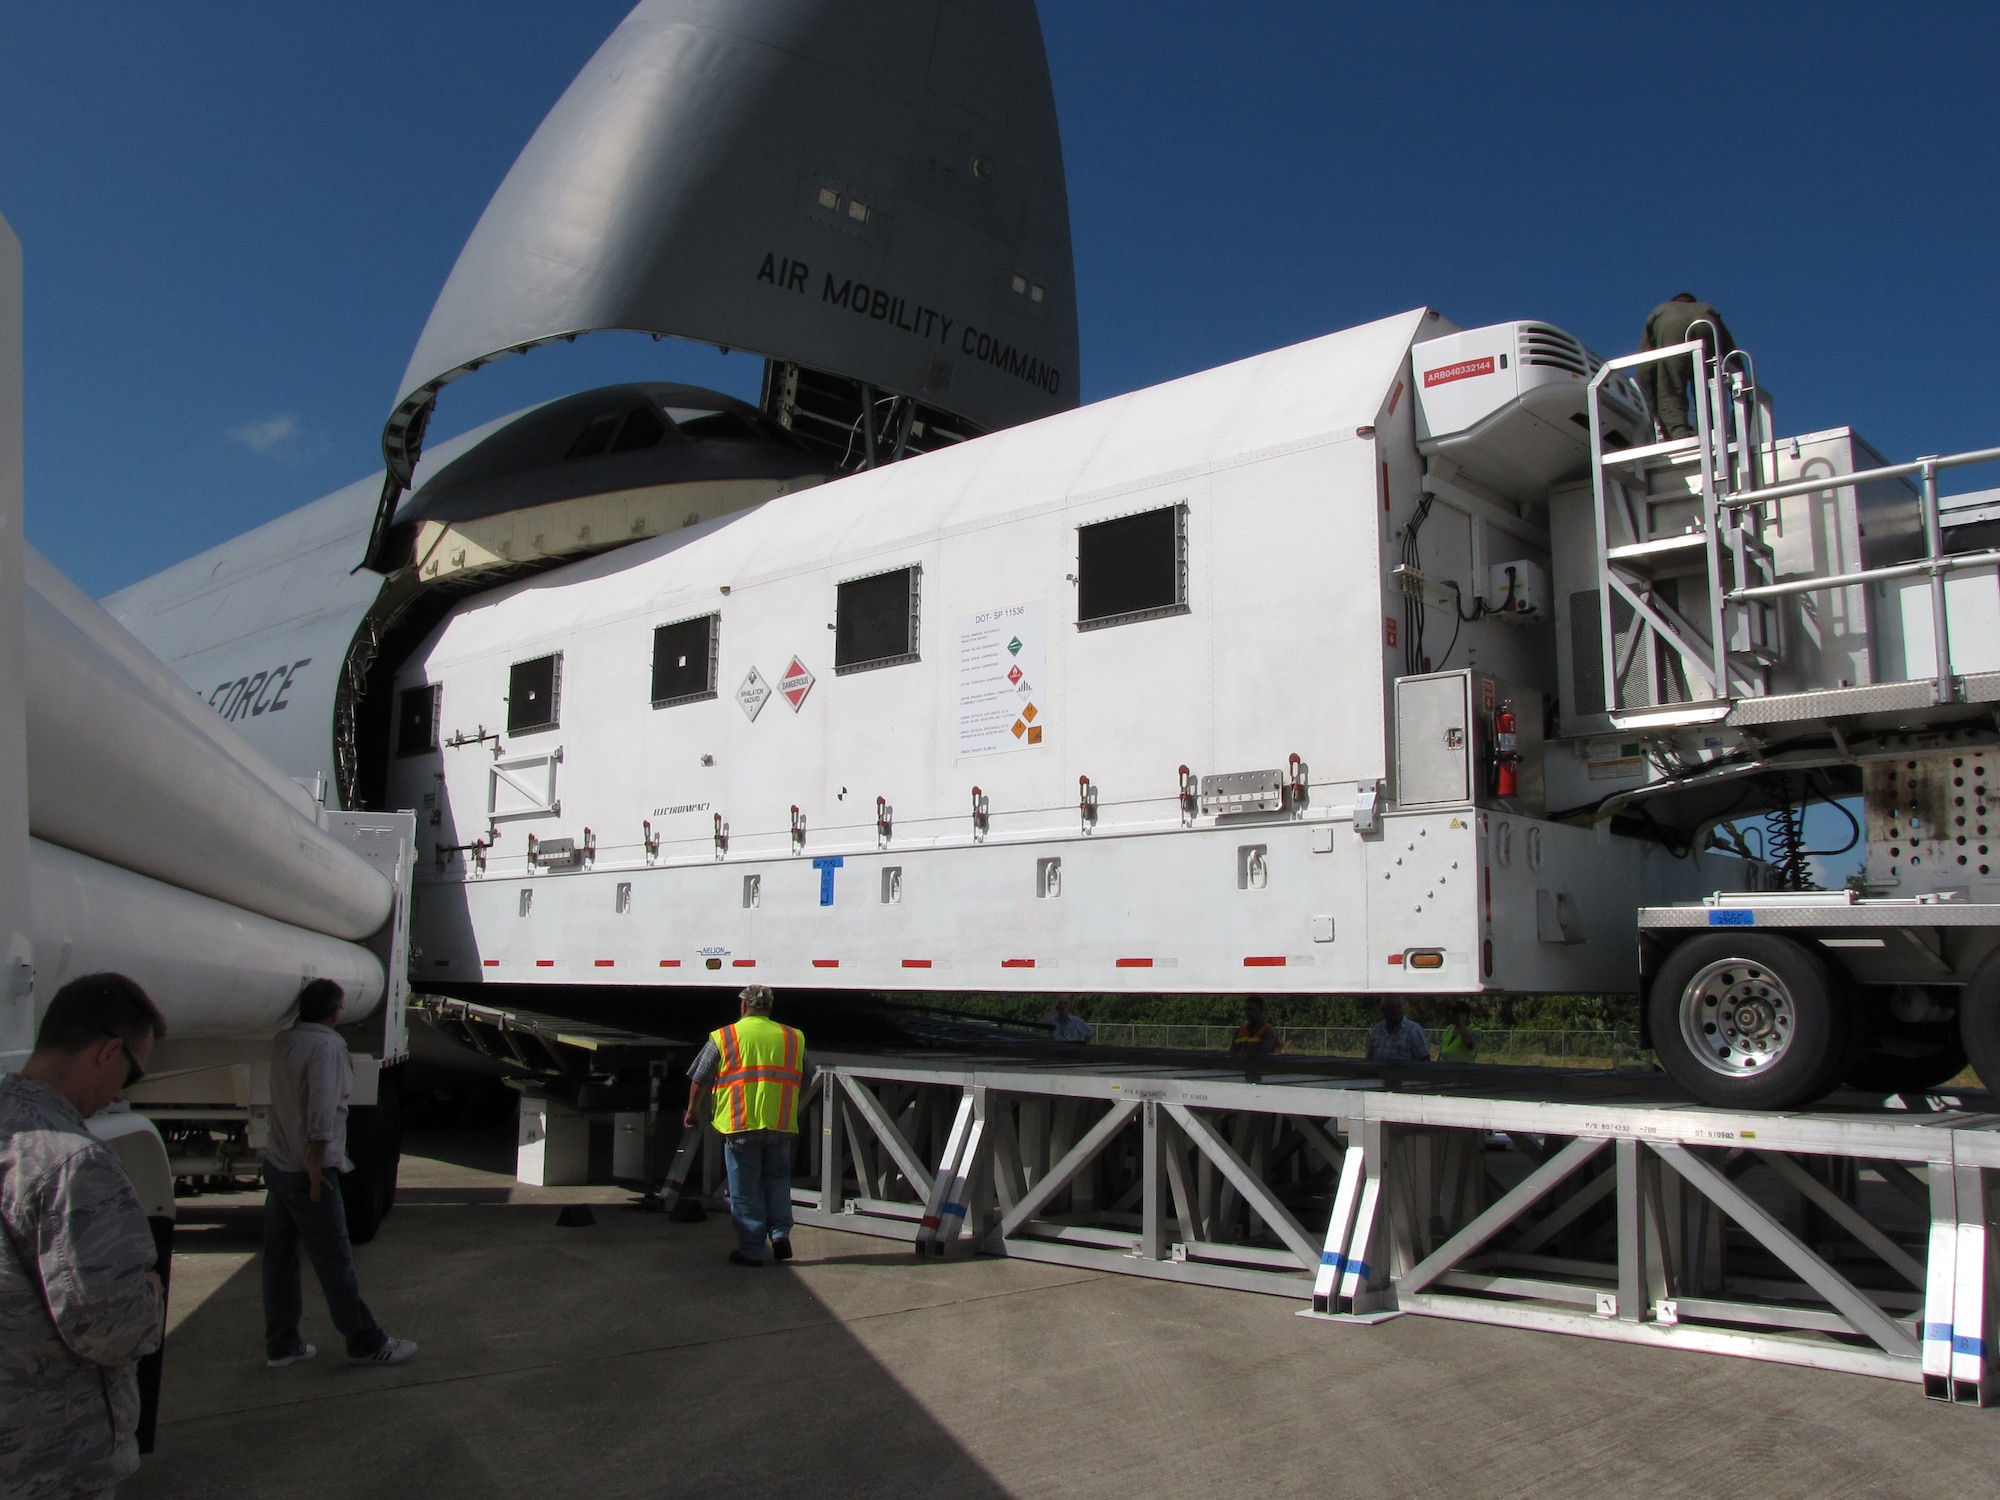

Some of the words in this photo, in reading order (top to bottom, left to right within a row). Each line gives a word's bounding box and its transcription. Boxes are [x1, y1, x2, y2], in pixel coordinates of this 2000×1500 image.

[757, 252, 809, 294] AIR
[822, 272, 953, 344] MOBILITY
[962, 326, 1061, 396] COMMAND
[1427, 361, 1491, 382] ARB040332144
[994, 610, 1003, 621] SP
[1006, 606, 1025, 618] 11536
[208, 657, 313, 722] FORCE
[781, 676, 809, 690] DANGEROUS
[740, 688, 764, 698] INHALATION
[743, 696, 761, 704] HAZARD
[653, 802, 711, 817] ELECTROIMPACT
[702, 946, 726, 954] NELSON
